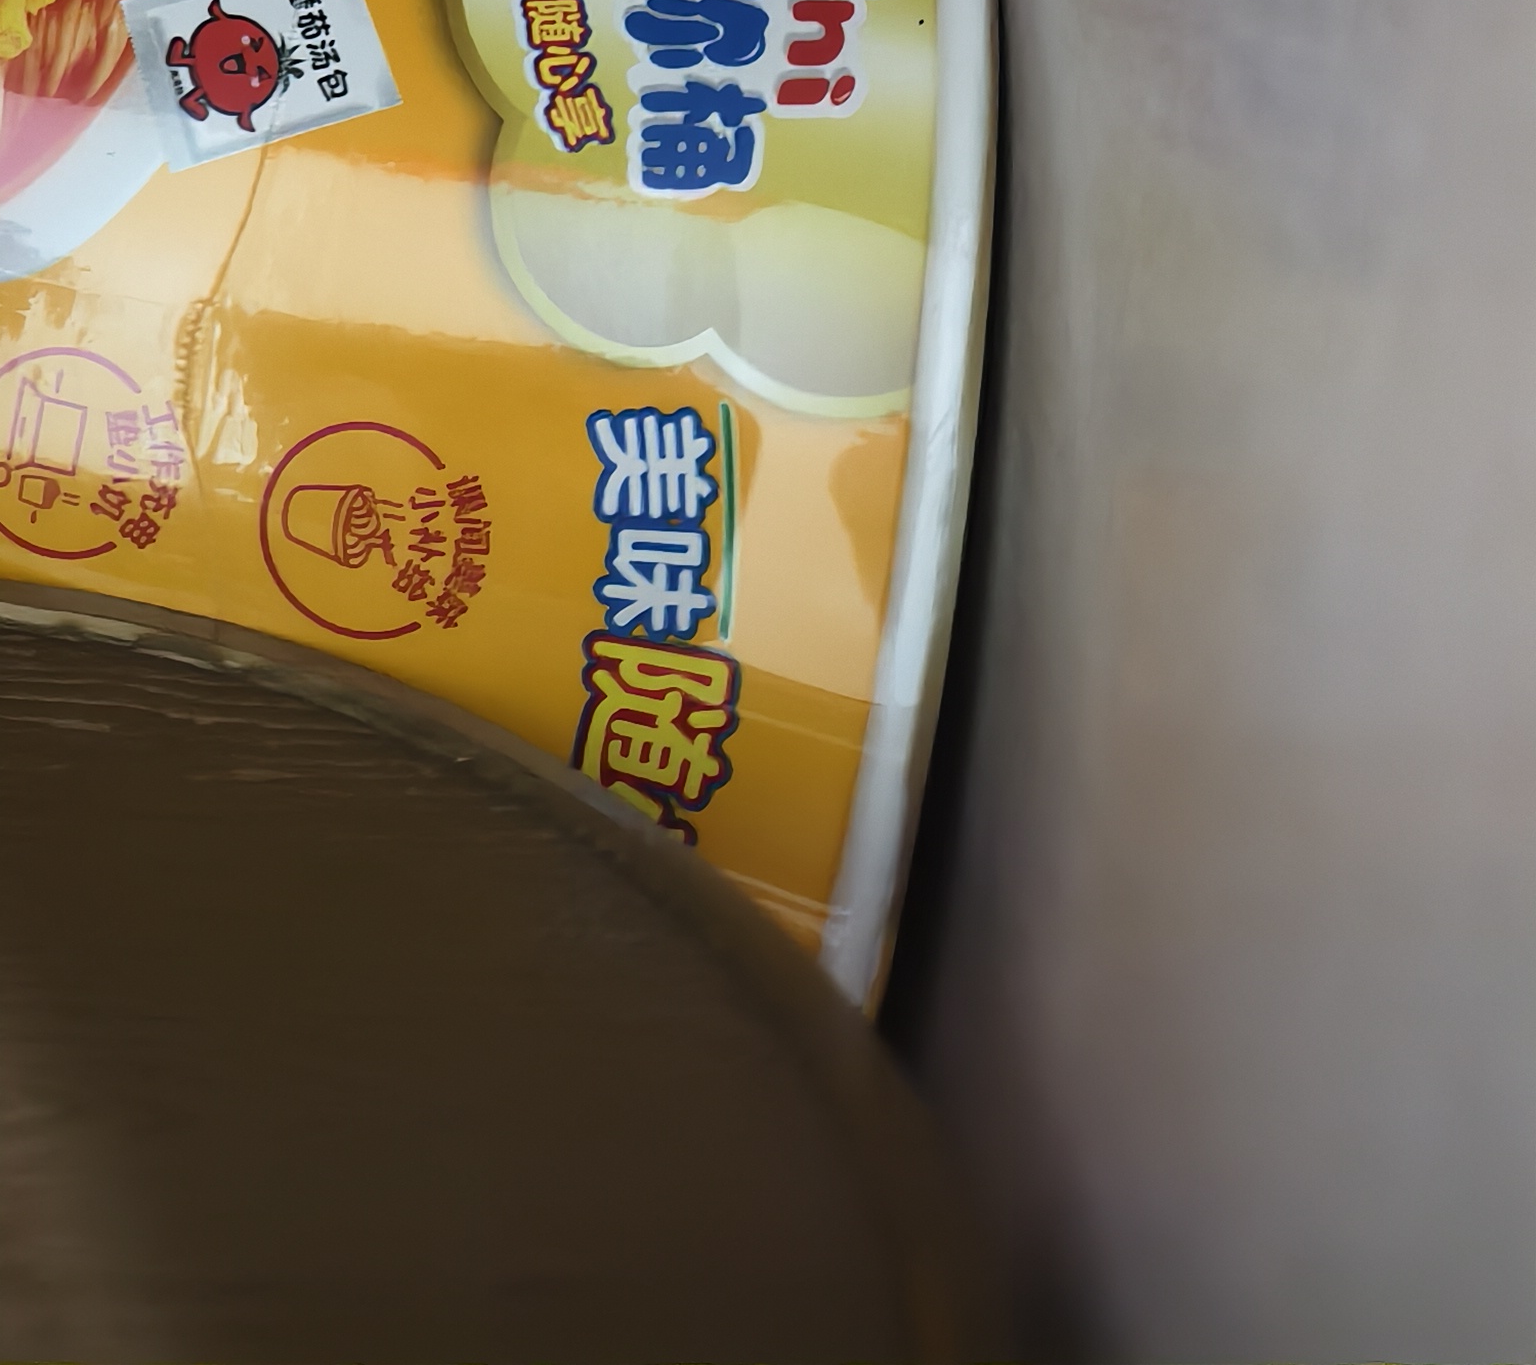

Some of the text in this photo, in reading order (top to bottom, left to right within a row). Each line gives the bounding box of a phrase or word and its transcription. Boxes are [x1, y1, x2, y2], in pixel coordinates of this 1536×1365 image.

[118, 399, 185, 550] 工作充电
[584, 408, 737, 844] 美味随
